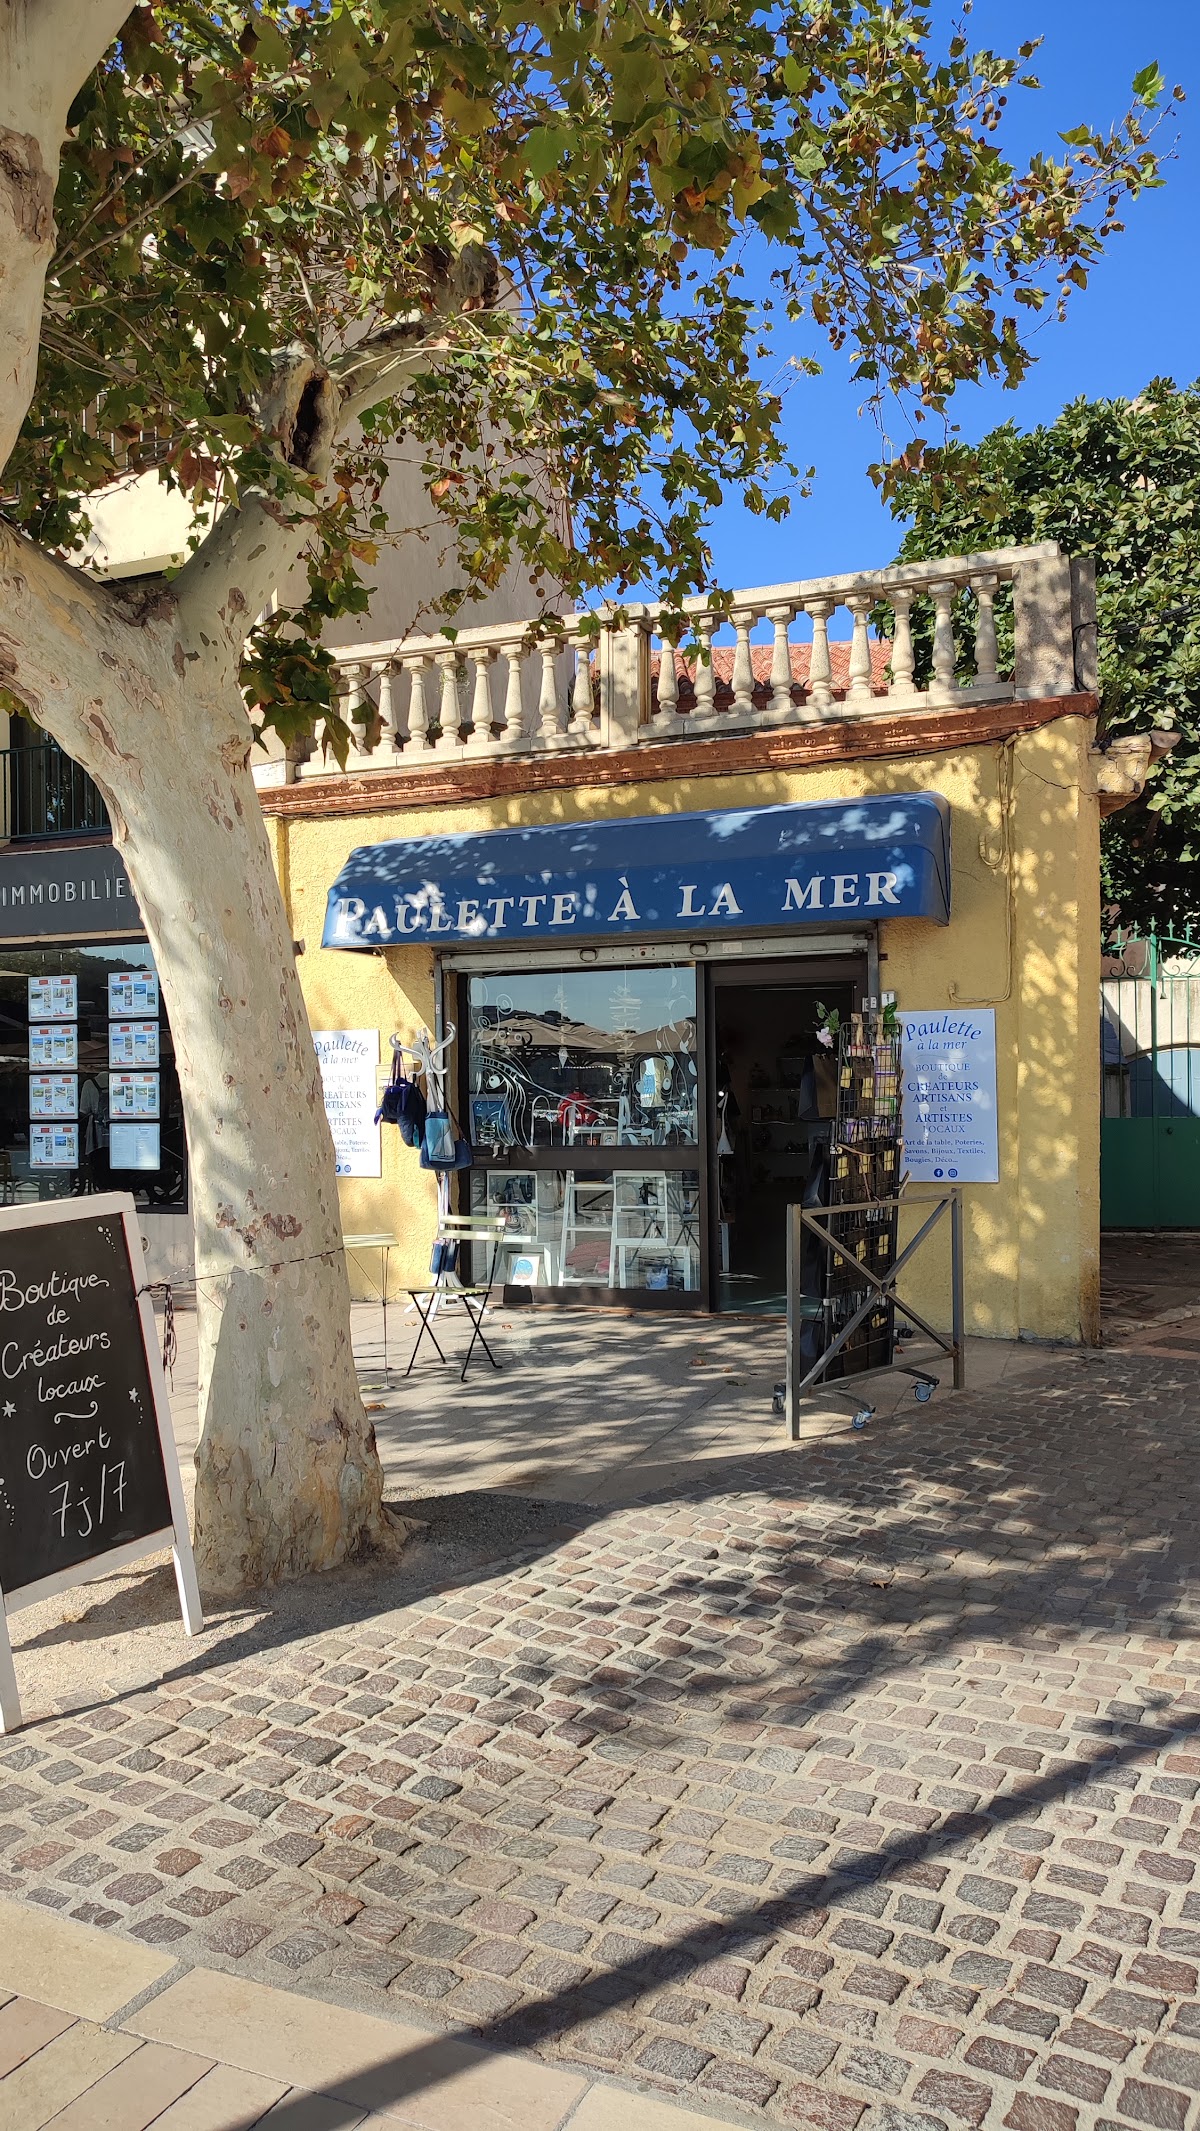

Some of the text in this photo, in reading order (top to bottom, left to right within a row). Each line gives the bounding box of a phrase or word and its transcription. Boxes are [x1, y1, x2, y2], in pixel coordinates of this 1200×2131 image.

[2, 877, 135, 906] IMMOBILIE
[333, 872, 900, 937] PAULETTE À LA MER
[906, 1015, 982, 1042] Paulette
[314, 1034, 369, 1056] Paulette
[917, 1039, 967, 1051] à la mer
[322, 1055, 328, 1064] à
[330, 1054, 338, 1064] la
[915, 1063, 971, 1073] BOUTIQUE
[938, 1072, 948, 1080] de
[325, 1100, 362, 1109] RTISANS
[912, 1092, 972, 1103] ARTISANS
[327, 1117, 362, 1126] RTISTES
[915, 1113, 973, 1123] ARTISTES
[957, 1147, 986, 1155] Textiles,
[0, 1269, 110, 1312] Boutique
[46, 1304, 71, 1326] de
[1, 1332, 111, 1379] Créateurs
[38, 1374, 106, 1402] locaux
[26, 1425, 111, 1479] Ouvert
[48, 1460, 128, 1538] 7j/7
